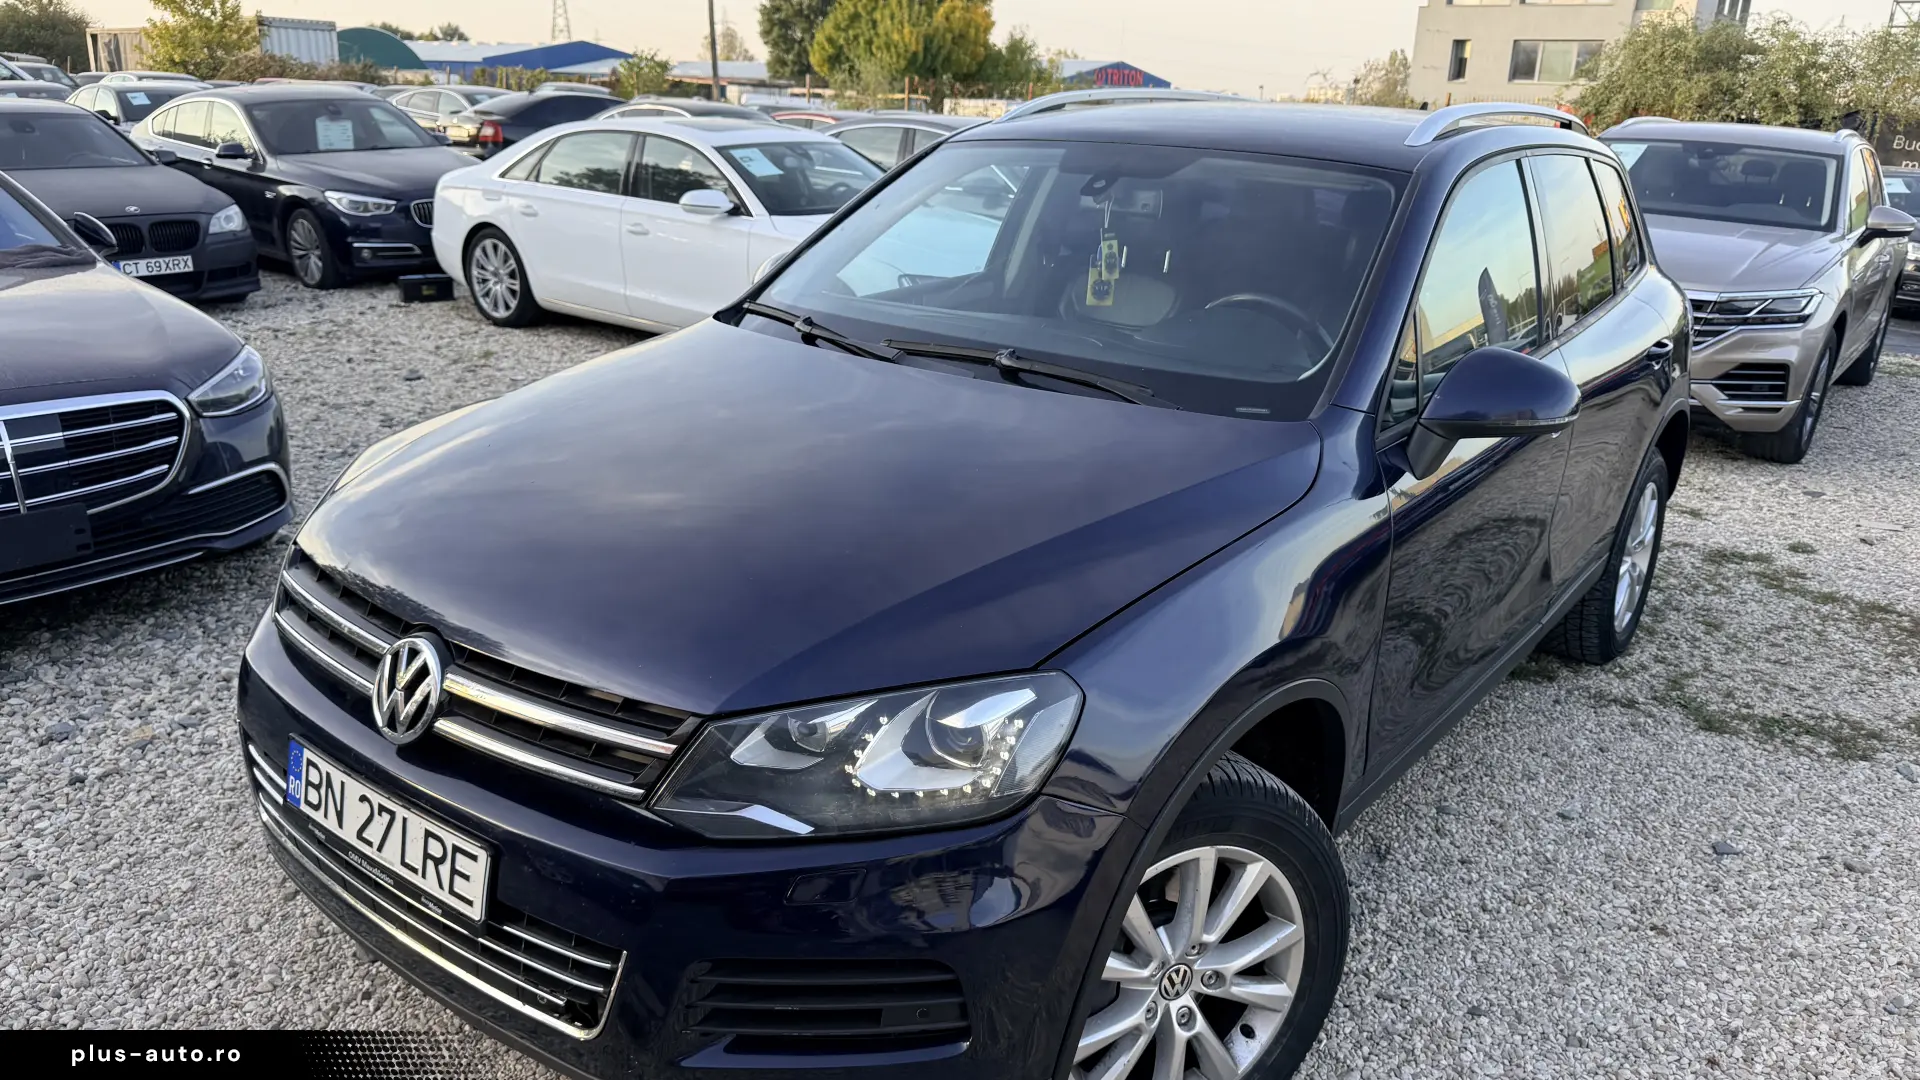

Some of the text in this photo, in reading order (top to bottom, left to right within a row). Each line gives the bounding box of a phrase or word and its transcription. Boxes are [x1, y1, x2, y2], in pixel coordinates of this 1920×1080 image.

[1107, 68, 1144, 86] TRITON
[122, 262, 140, 276] CT
[289, 775, 301, 799] RO
[303, 756, 346, 831] BN
